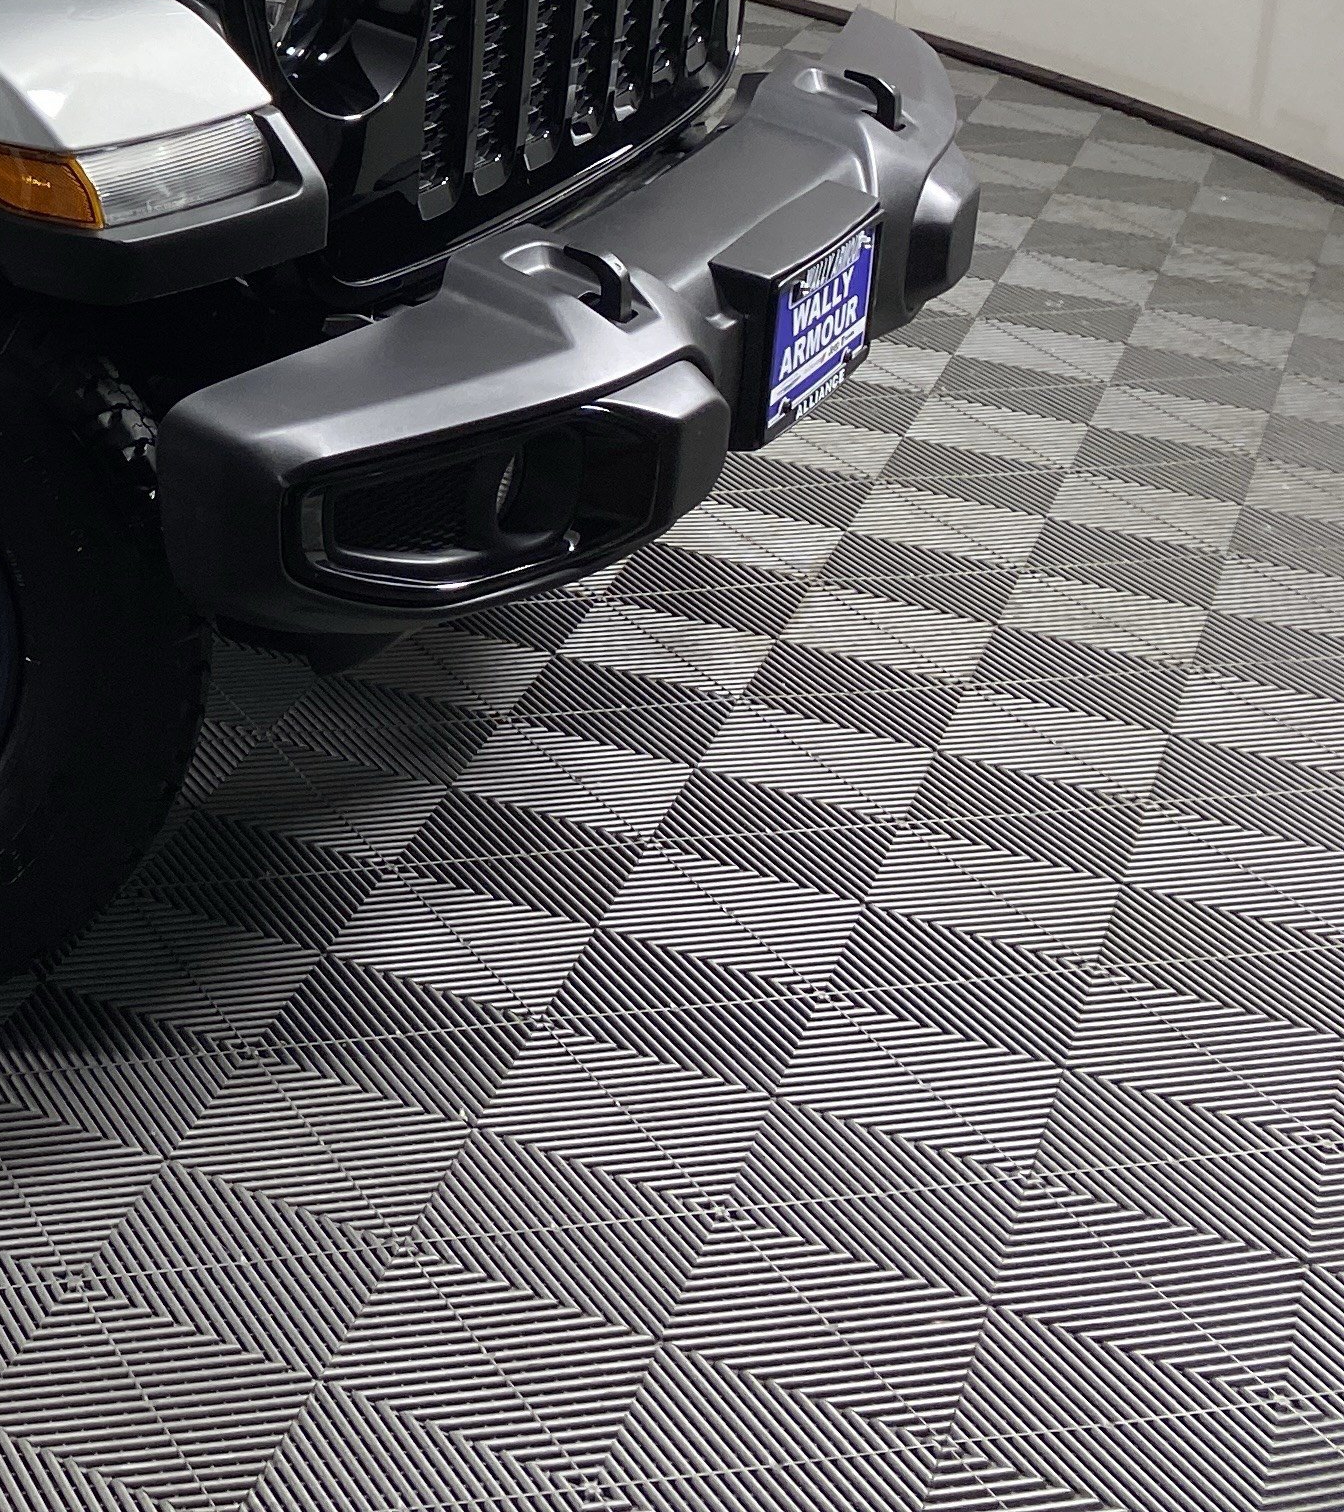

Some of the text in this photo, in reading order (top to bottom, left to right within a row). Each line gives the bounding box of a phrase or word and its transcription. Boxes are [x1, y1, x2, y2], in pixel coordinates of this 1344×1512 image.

[792, 265, 855, 337] WALLY
[778, 295, 859, 382] ARMOUR
[795, 368, 846, 421] ALLIANCE
